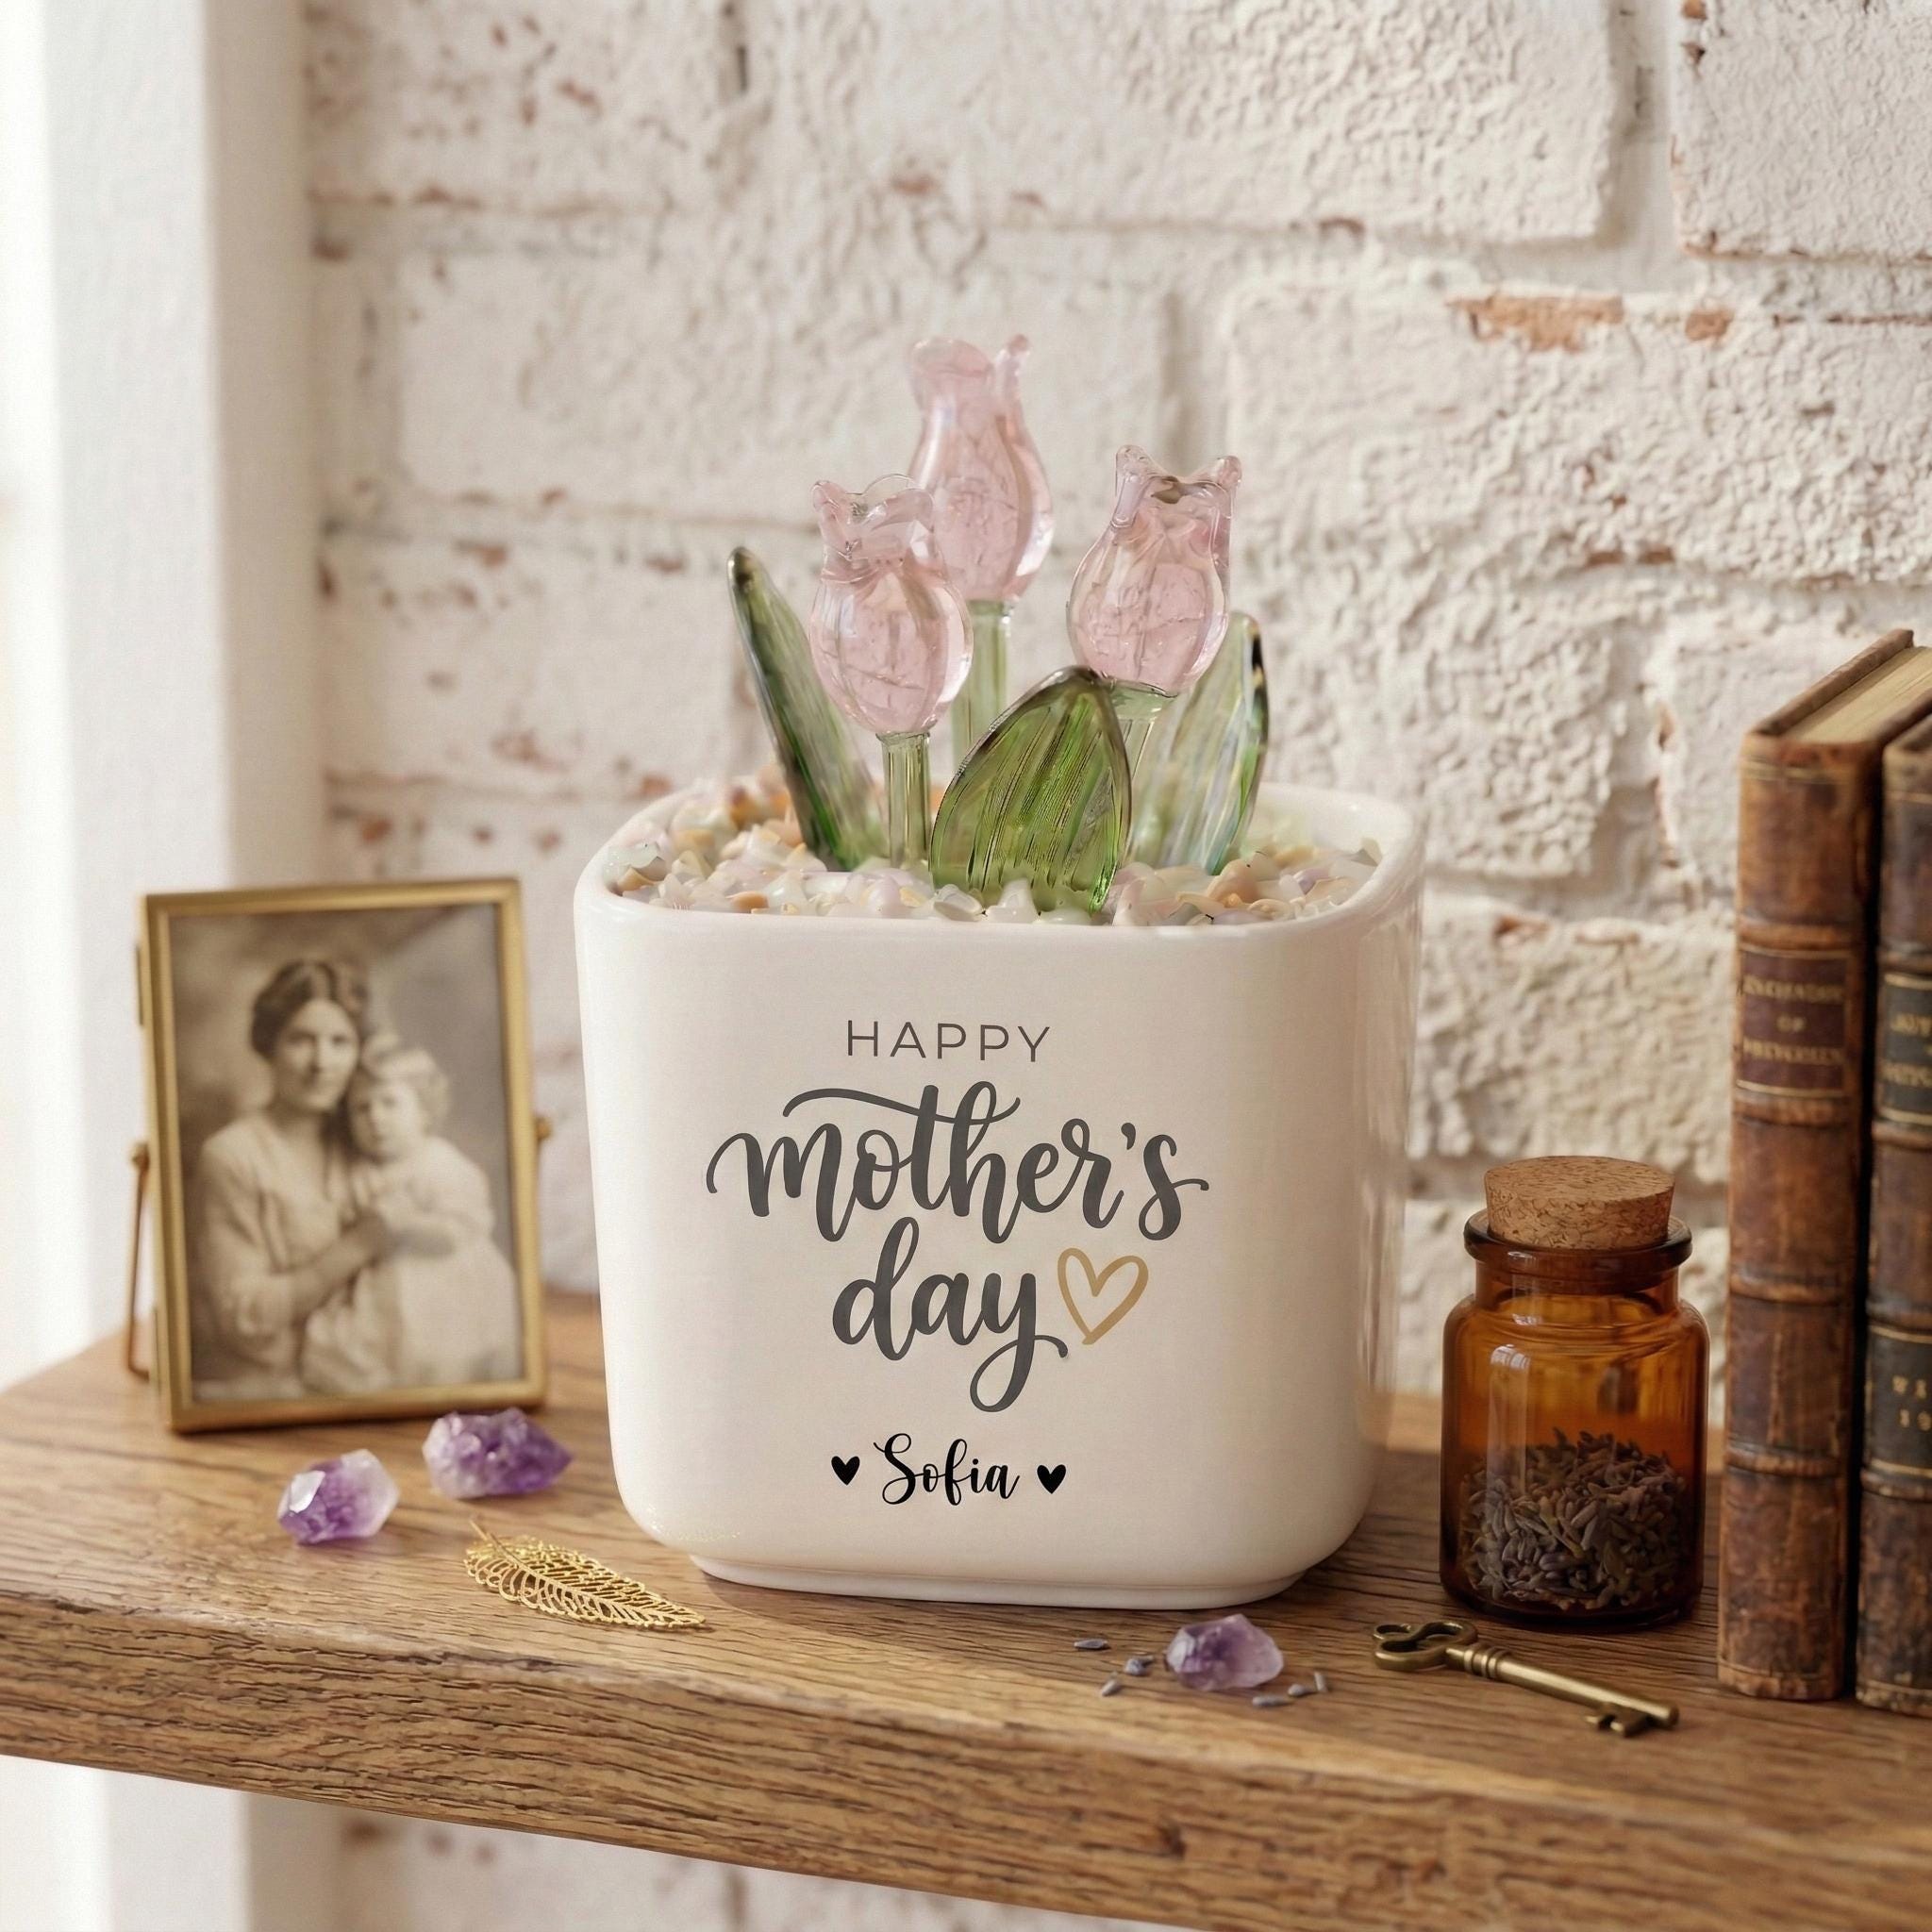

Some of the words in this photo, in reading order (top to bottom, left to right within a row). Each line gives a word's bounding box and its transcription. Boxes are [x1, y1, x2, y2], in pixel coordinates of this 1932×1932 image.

[846, 1019, 1051, 1063] HAPPY
[706, 1080, 1210, 1244] mother's
[832, 1216, 1069, 1413] day
[873, 1432, 1021, 1507] Sofia
